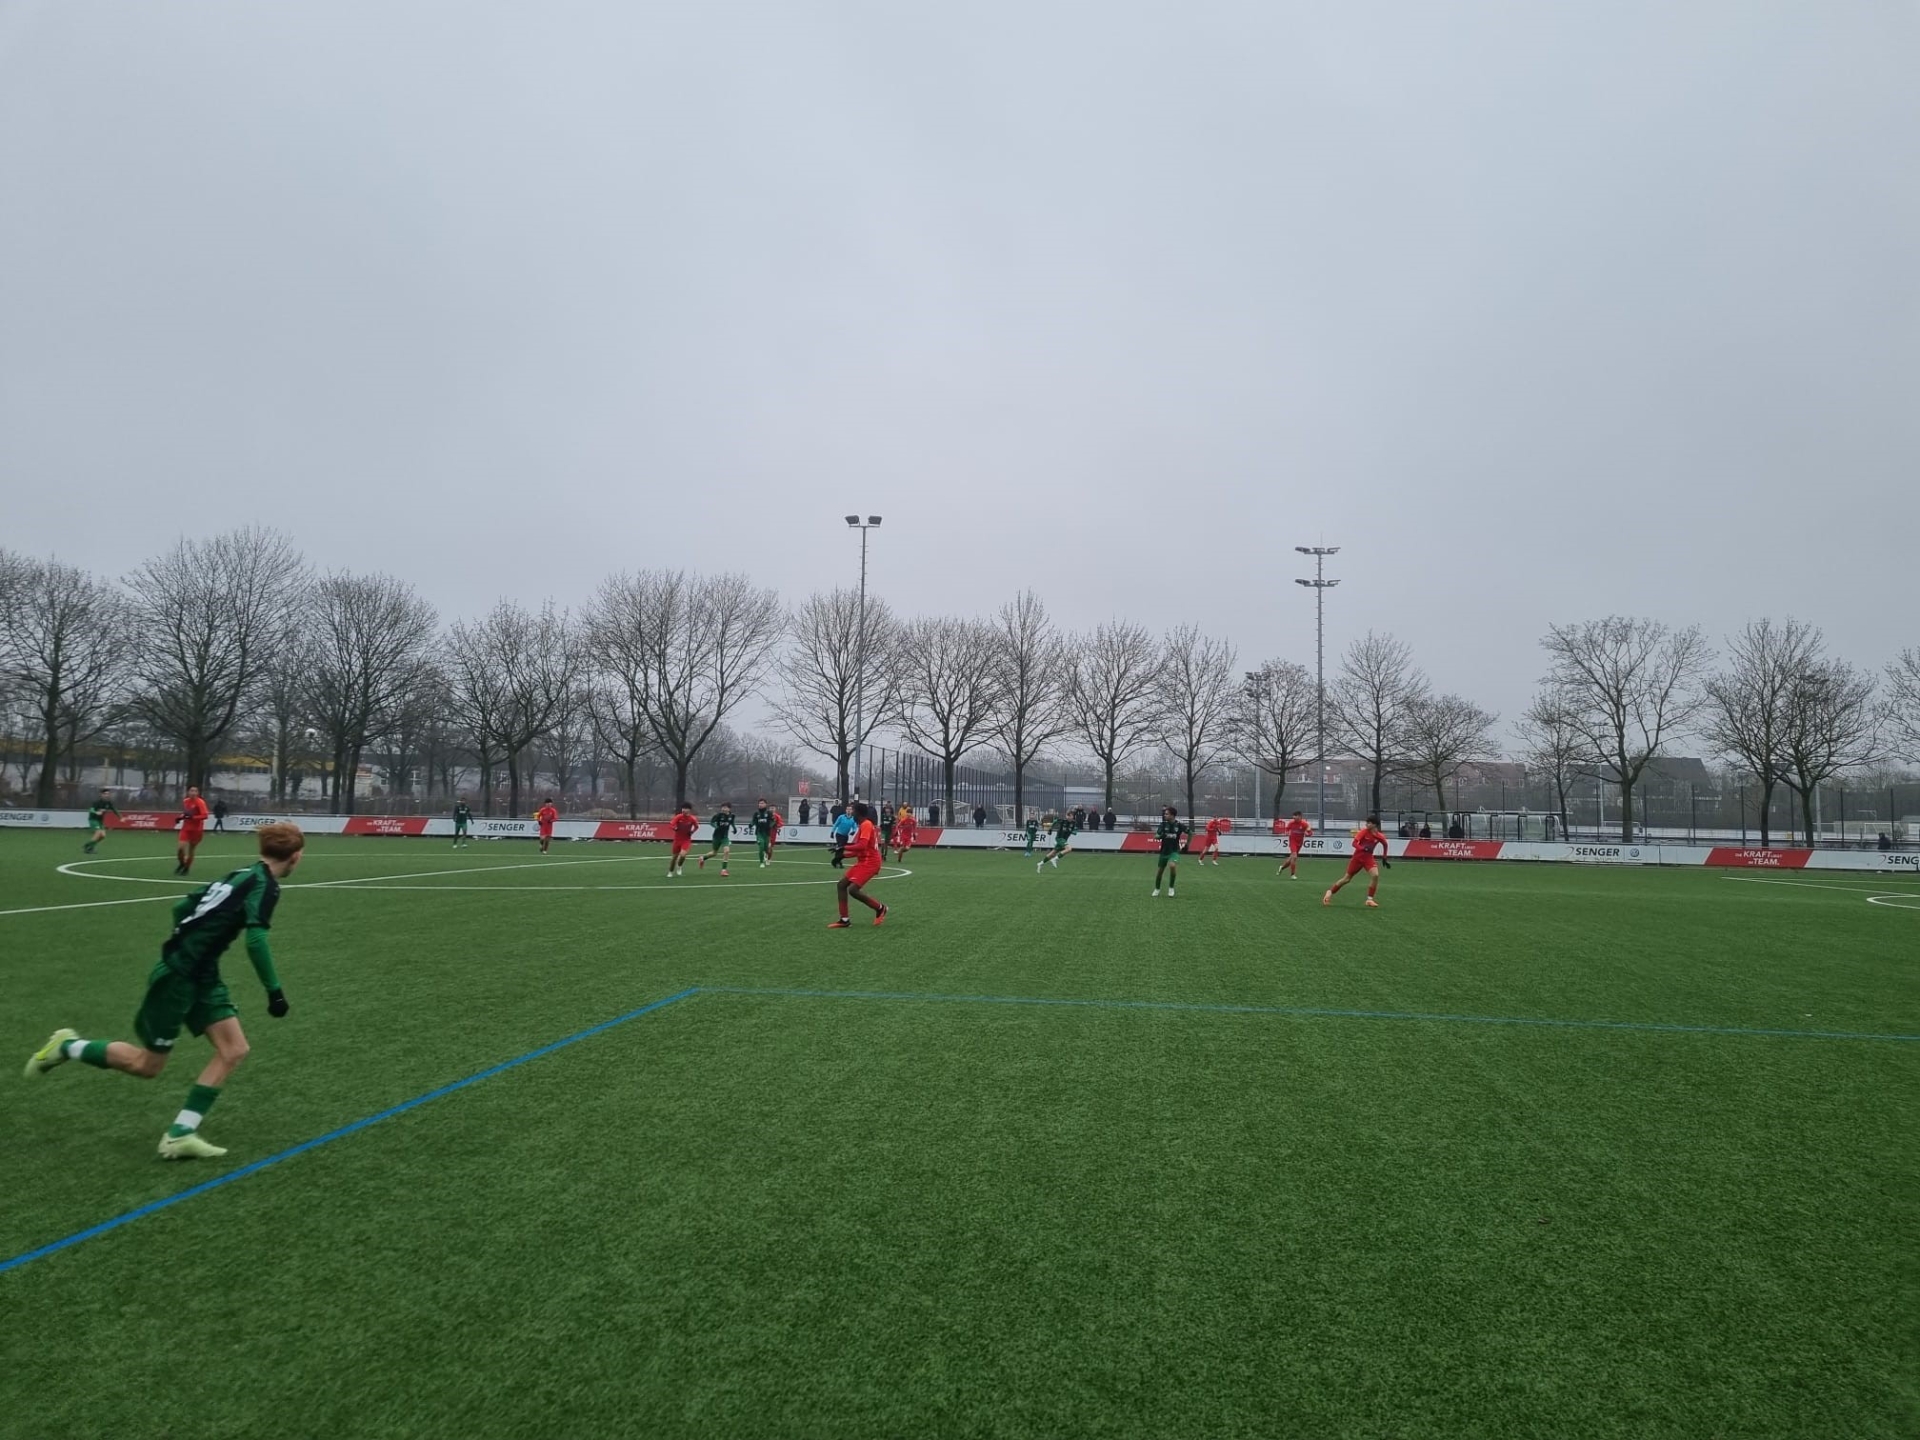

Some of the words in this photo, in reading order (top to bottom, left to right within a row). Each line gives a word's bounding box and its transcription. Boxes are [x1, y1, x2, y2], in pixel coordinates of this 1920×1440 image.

[0, 812, 34, 821] SENGER
[487, 823, 525, 832] SENGER
[1007, 832, 1046, 842] SENER
[1282, 839, 1324, 849] SGER
[1438, 842, 1466, 850] KRAFT
[1575, 847, 1620, 857] SENGER
[1743, 850, 1772, 858] KRAFT
